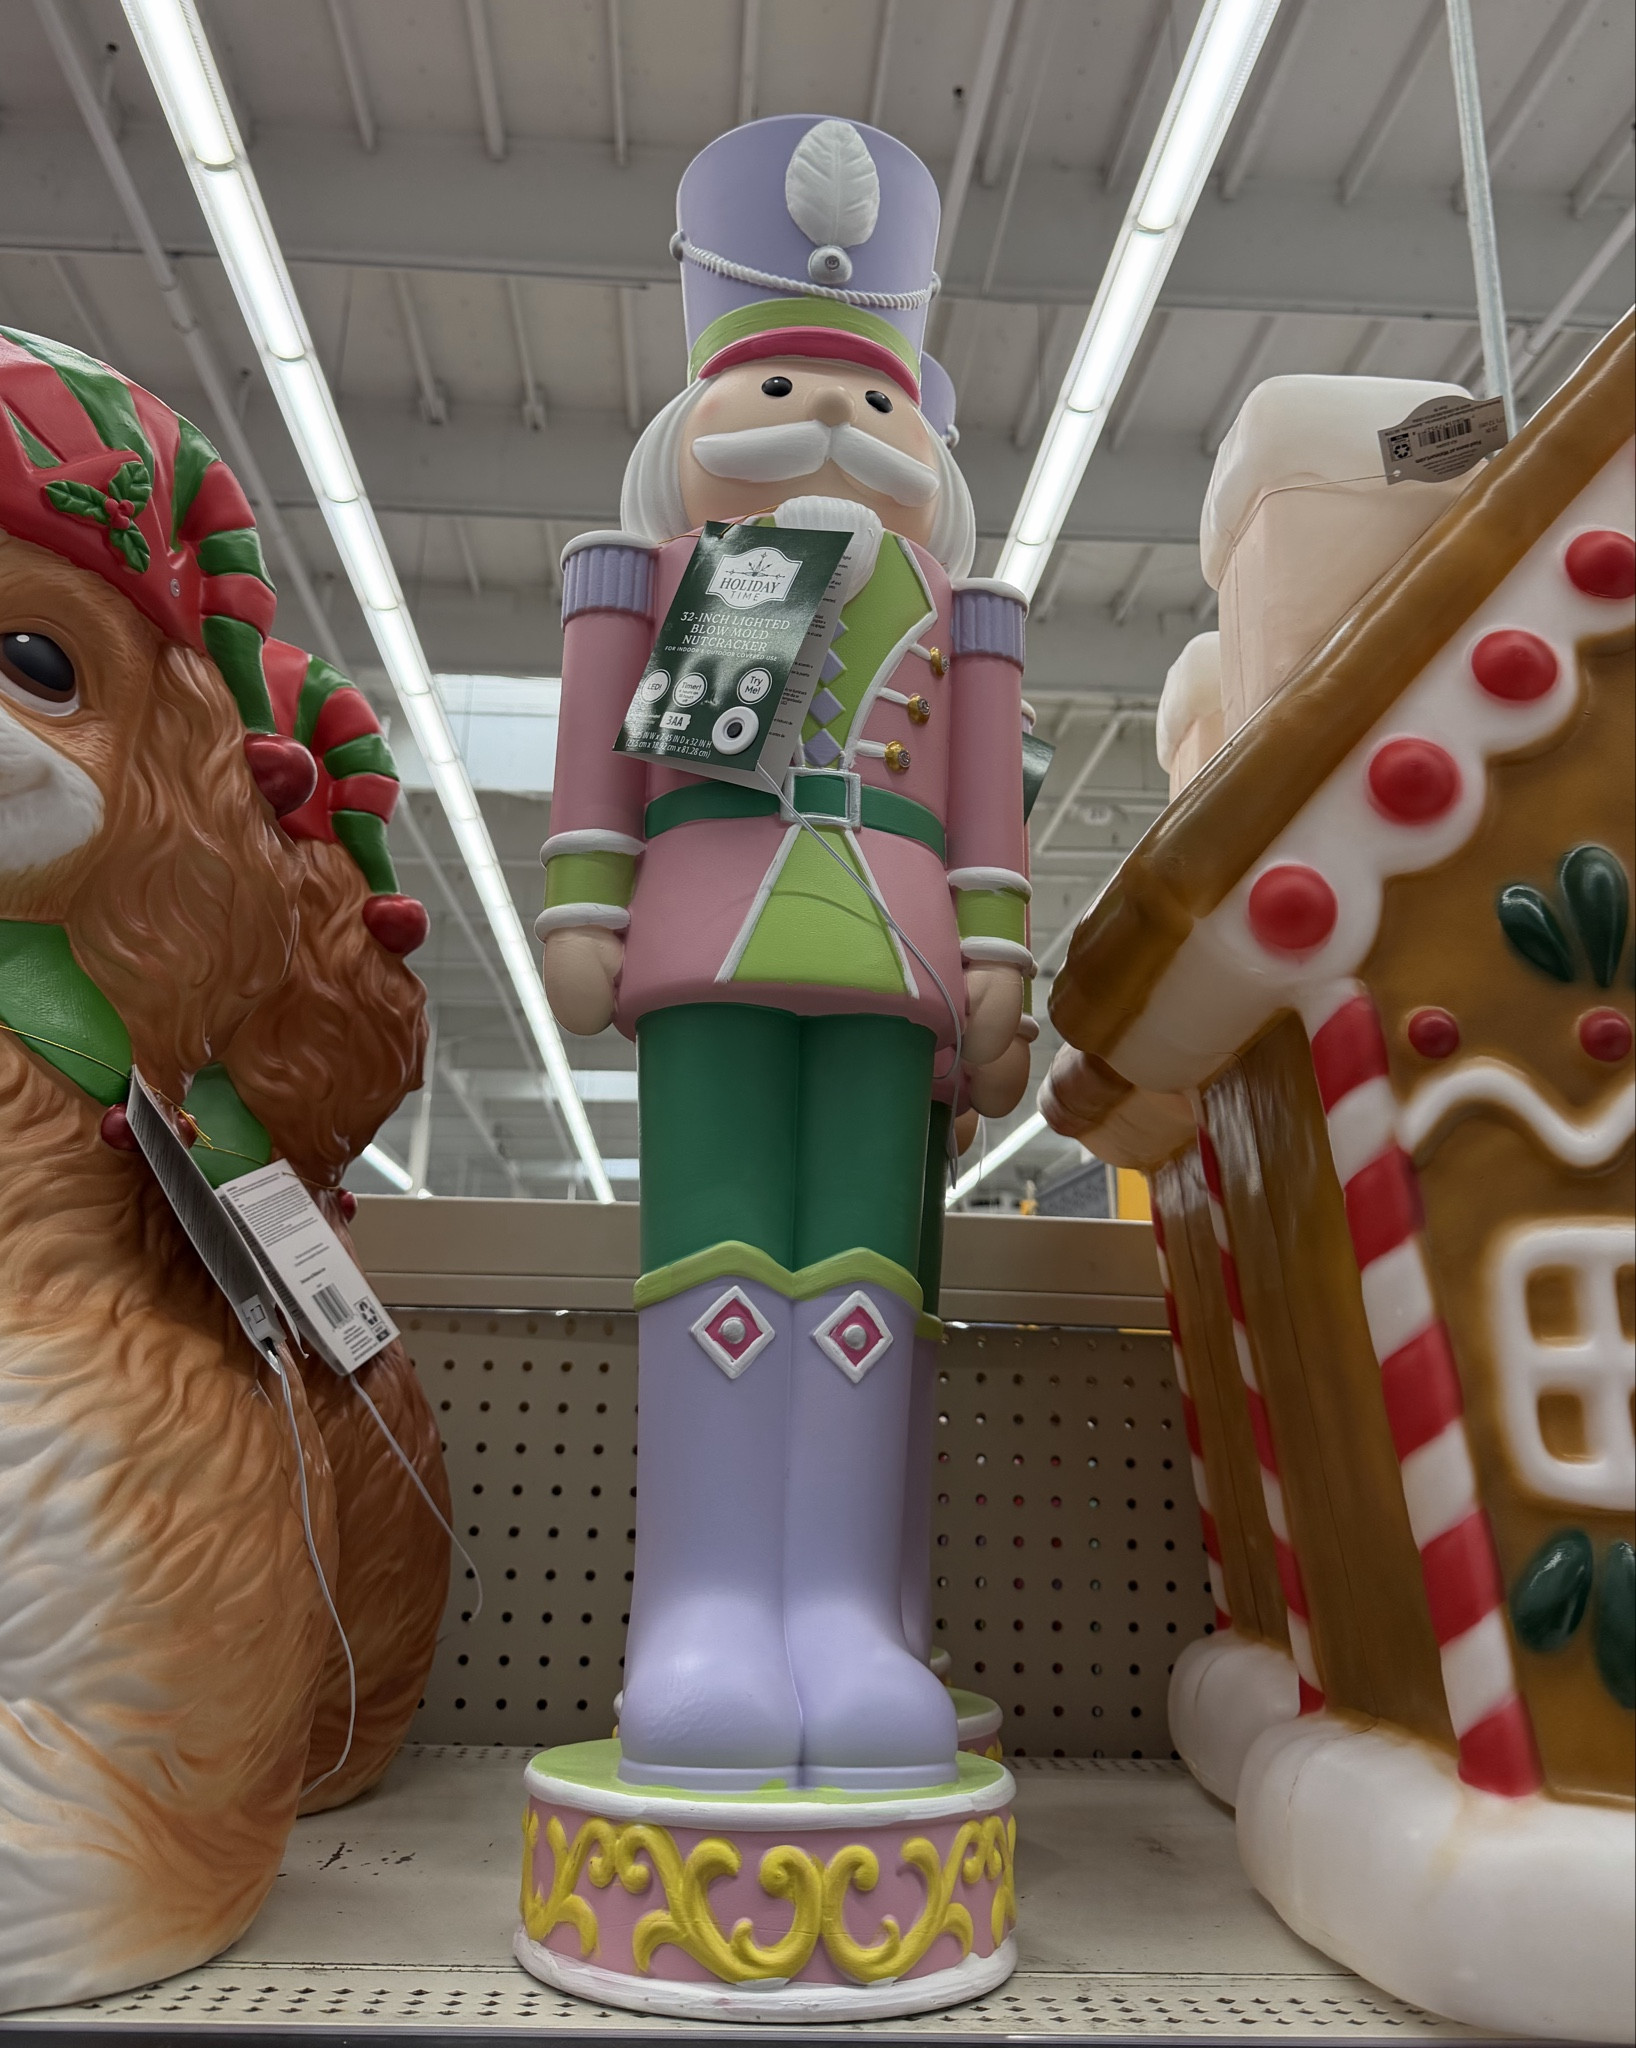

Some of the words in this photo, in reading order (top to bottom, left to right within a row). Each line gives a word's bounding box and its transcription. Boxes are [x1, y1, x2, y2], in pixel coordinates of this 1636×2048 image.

[720, 577, 780, 594] HOLIDAY
[730, 590, 761, 602] TIME
[680, 612, 730, 624] 32-INCH
[732, 616, 790, 630] LIGHTED
[690, 624, 730, 636] BLOW
[730, 629, 769, 640] MOLD
[682, 635, 768, 652] NUTCRACKER
[737, 652, 765, 660] COVERED
[681, 682, 702, 691] Timer!
[750, 676, 763, 686] Try
[745, 686, 761, 695] Me!
[666, 715, 684, 727] 3AA
[672, 735, 680, 743] IN
[680, 736, 686, 744] D
[690, 738, 699, 746] 32
[698, 739, 706, 748] IN
[706, 740, 713, 748] H
[681, 746, 699, 755] 81.28
[698, 750, 711, 759] cm)
